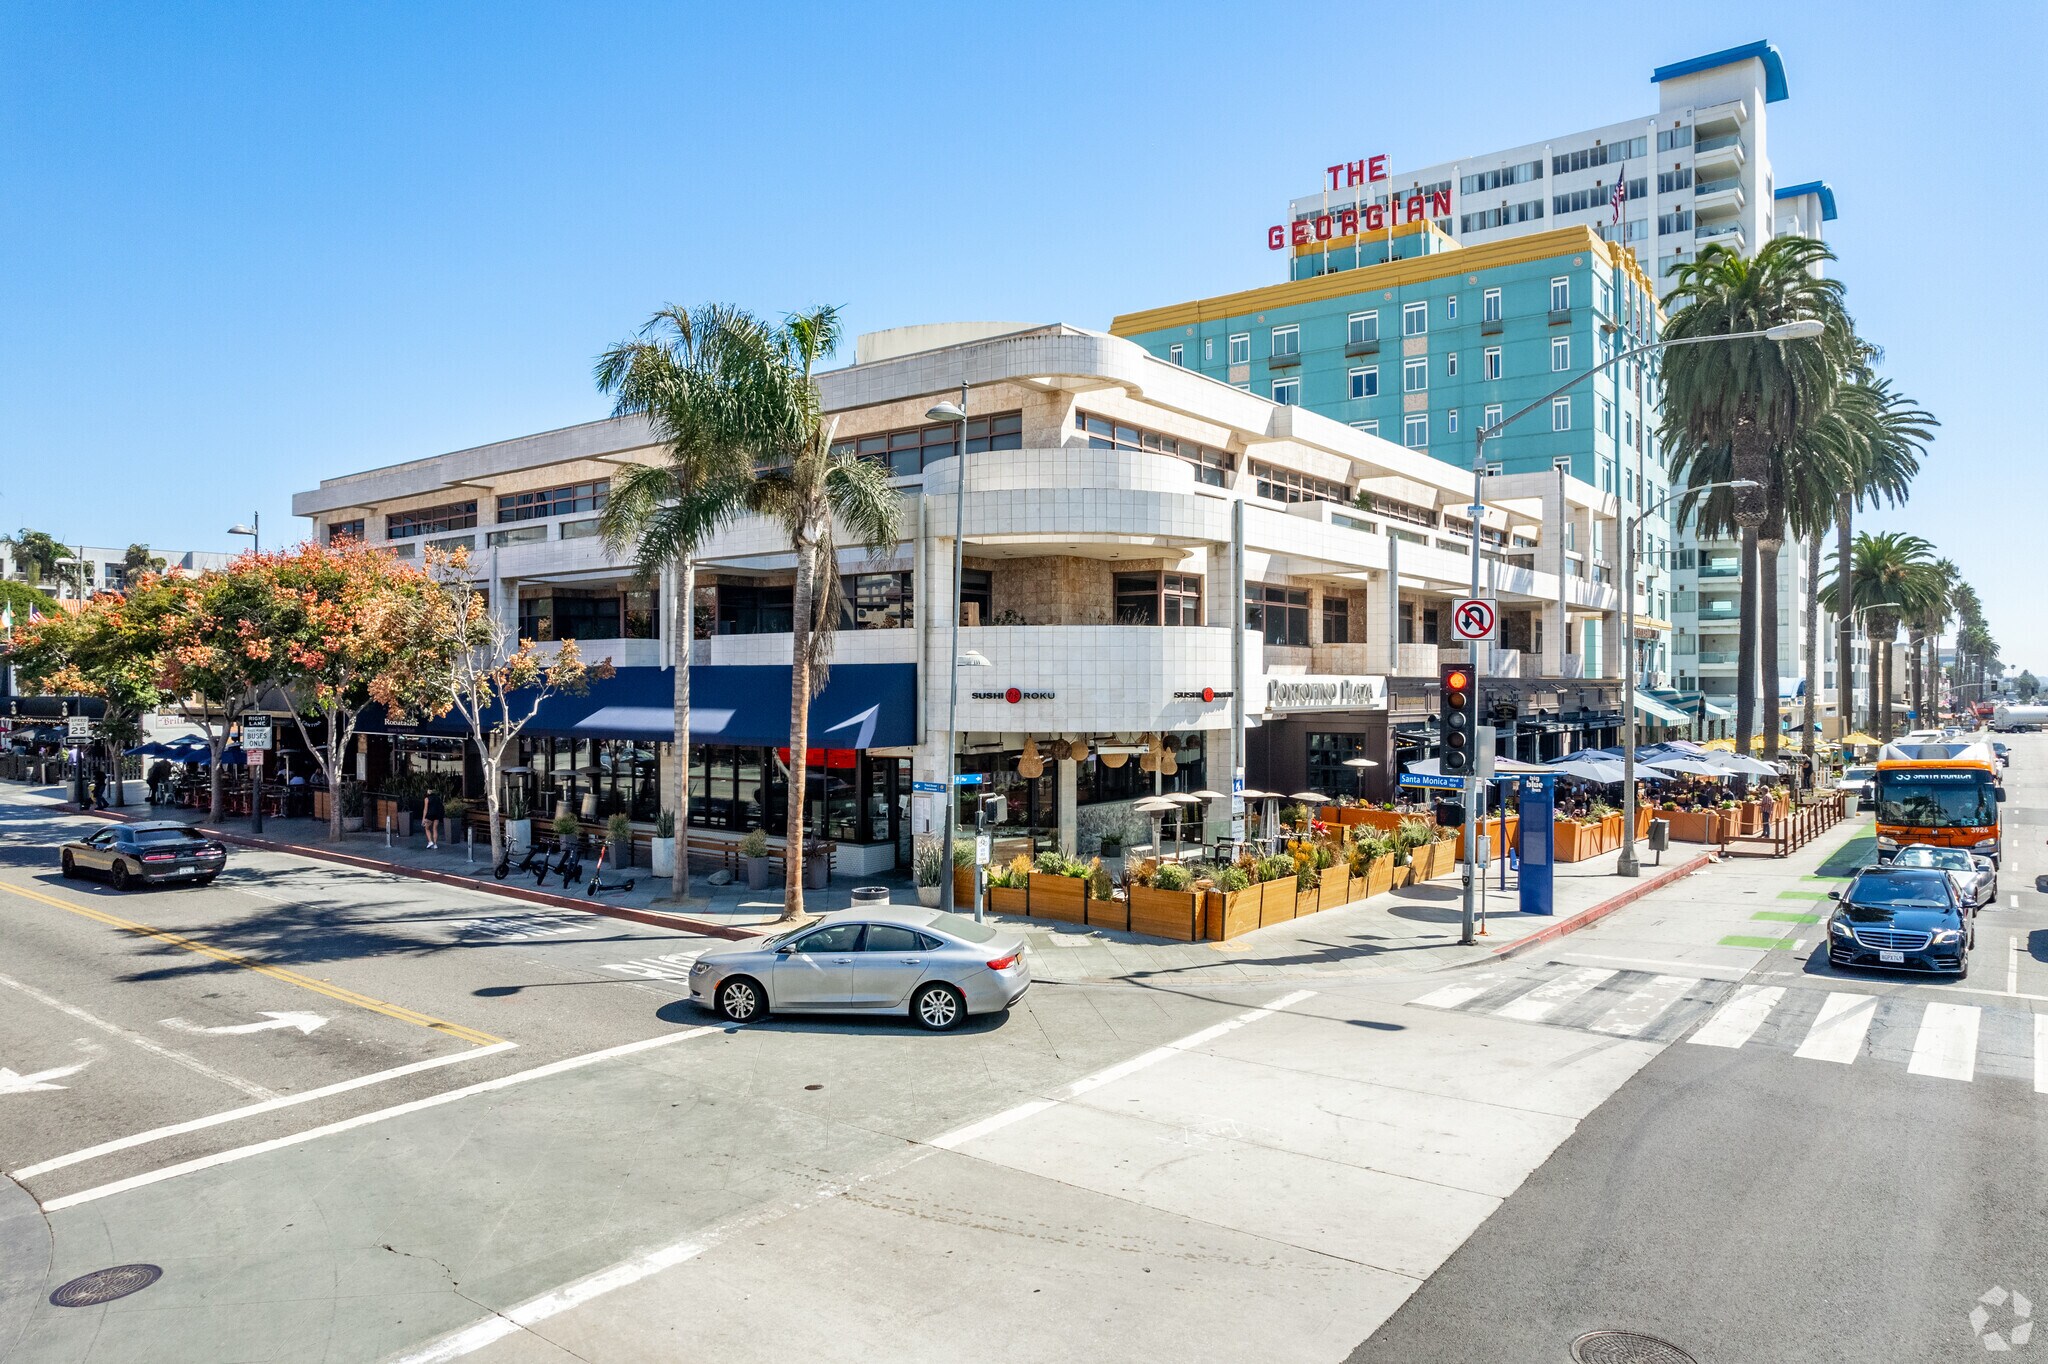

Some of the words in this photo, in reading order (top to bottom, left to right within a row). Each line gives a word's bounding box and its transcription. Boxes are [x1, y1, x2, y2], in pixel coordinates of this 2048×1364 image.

[1327, 154, 1387, 191] THE
[1268, 189, 1453, 251] GEORGIAN
[971, 692, 1004, 700] SUSHI
[1023, 692, 1055, 700] ROKU
[1340, 679, 1374, 701] PLAZA
[71, 726, 87, 735] 25
[1401, 774, 1421, 784] Santa
[1422, 776, 1448, 786] Monica
[1526, 780, 1544, 788] blue
